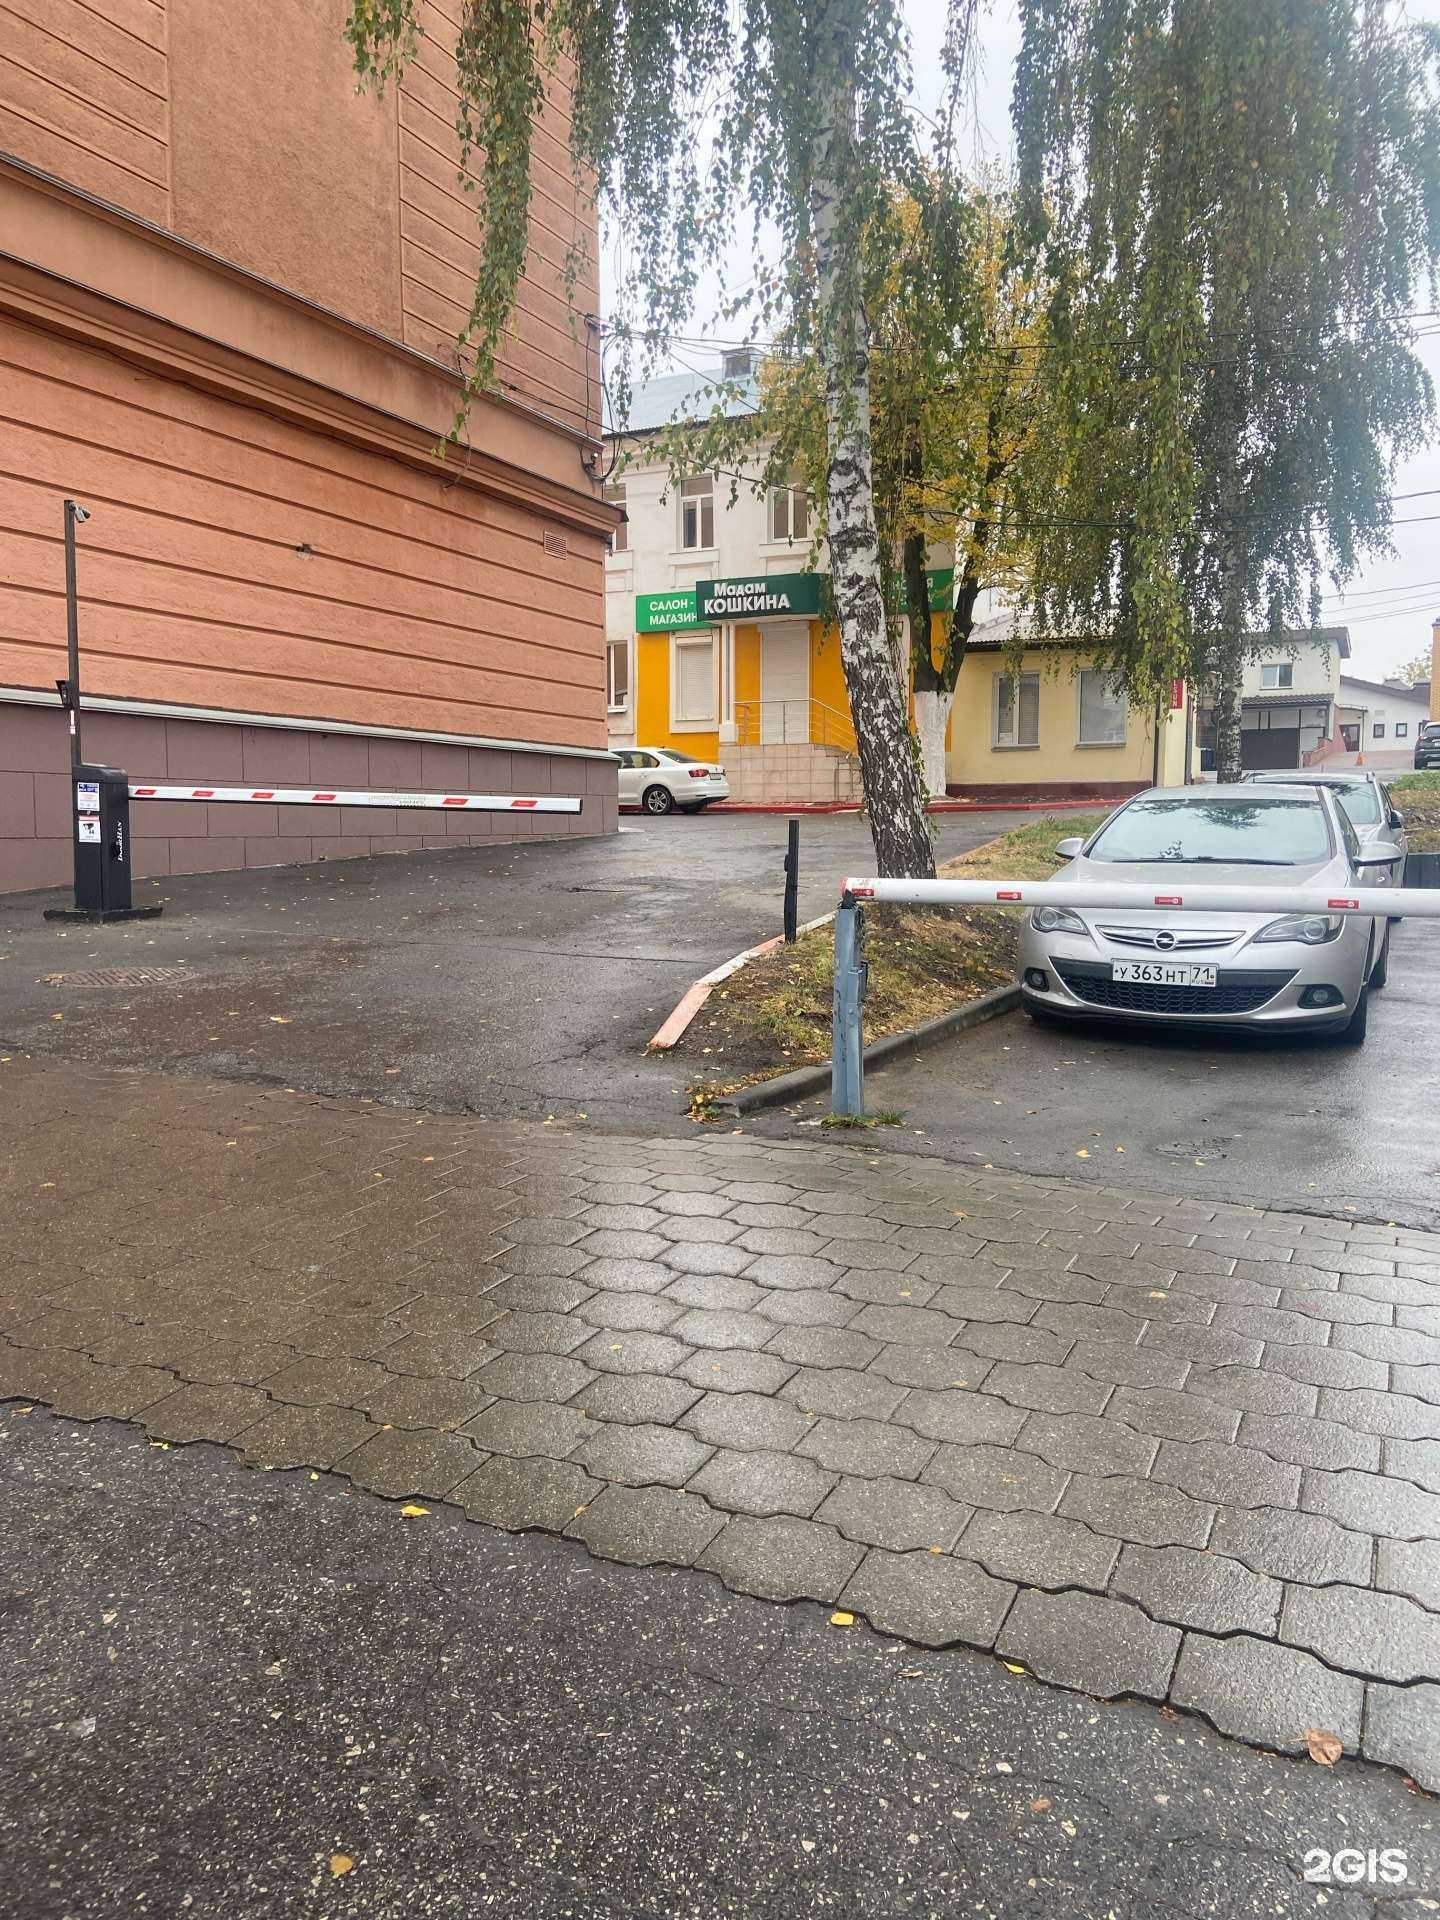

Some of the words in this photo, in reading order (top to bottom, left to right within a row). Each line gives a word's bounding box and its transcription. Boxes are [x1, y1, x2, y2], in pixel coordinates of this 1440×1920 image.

[714, 582, 766, 597] Мадам
[704, 593, 790, 614] КОШКИНА
[649, 611, 697, 625] МАГАЗИН
[1193, 967, 1210, 980] 71
